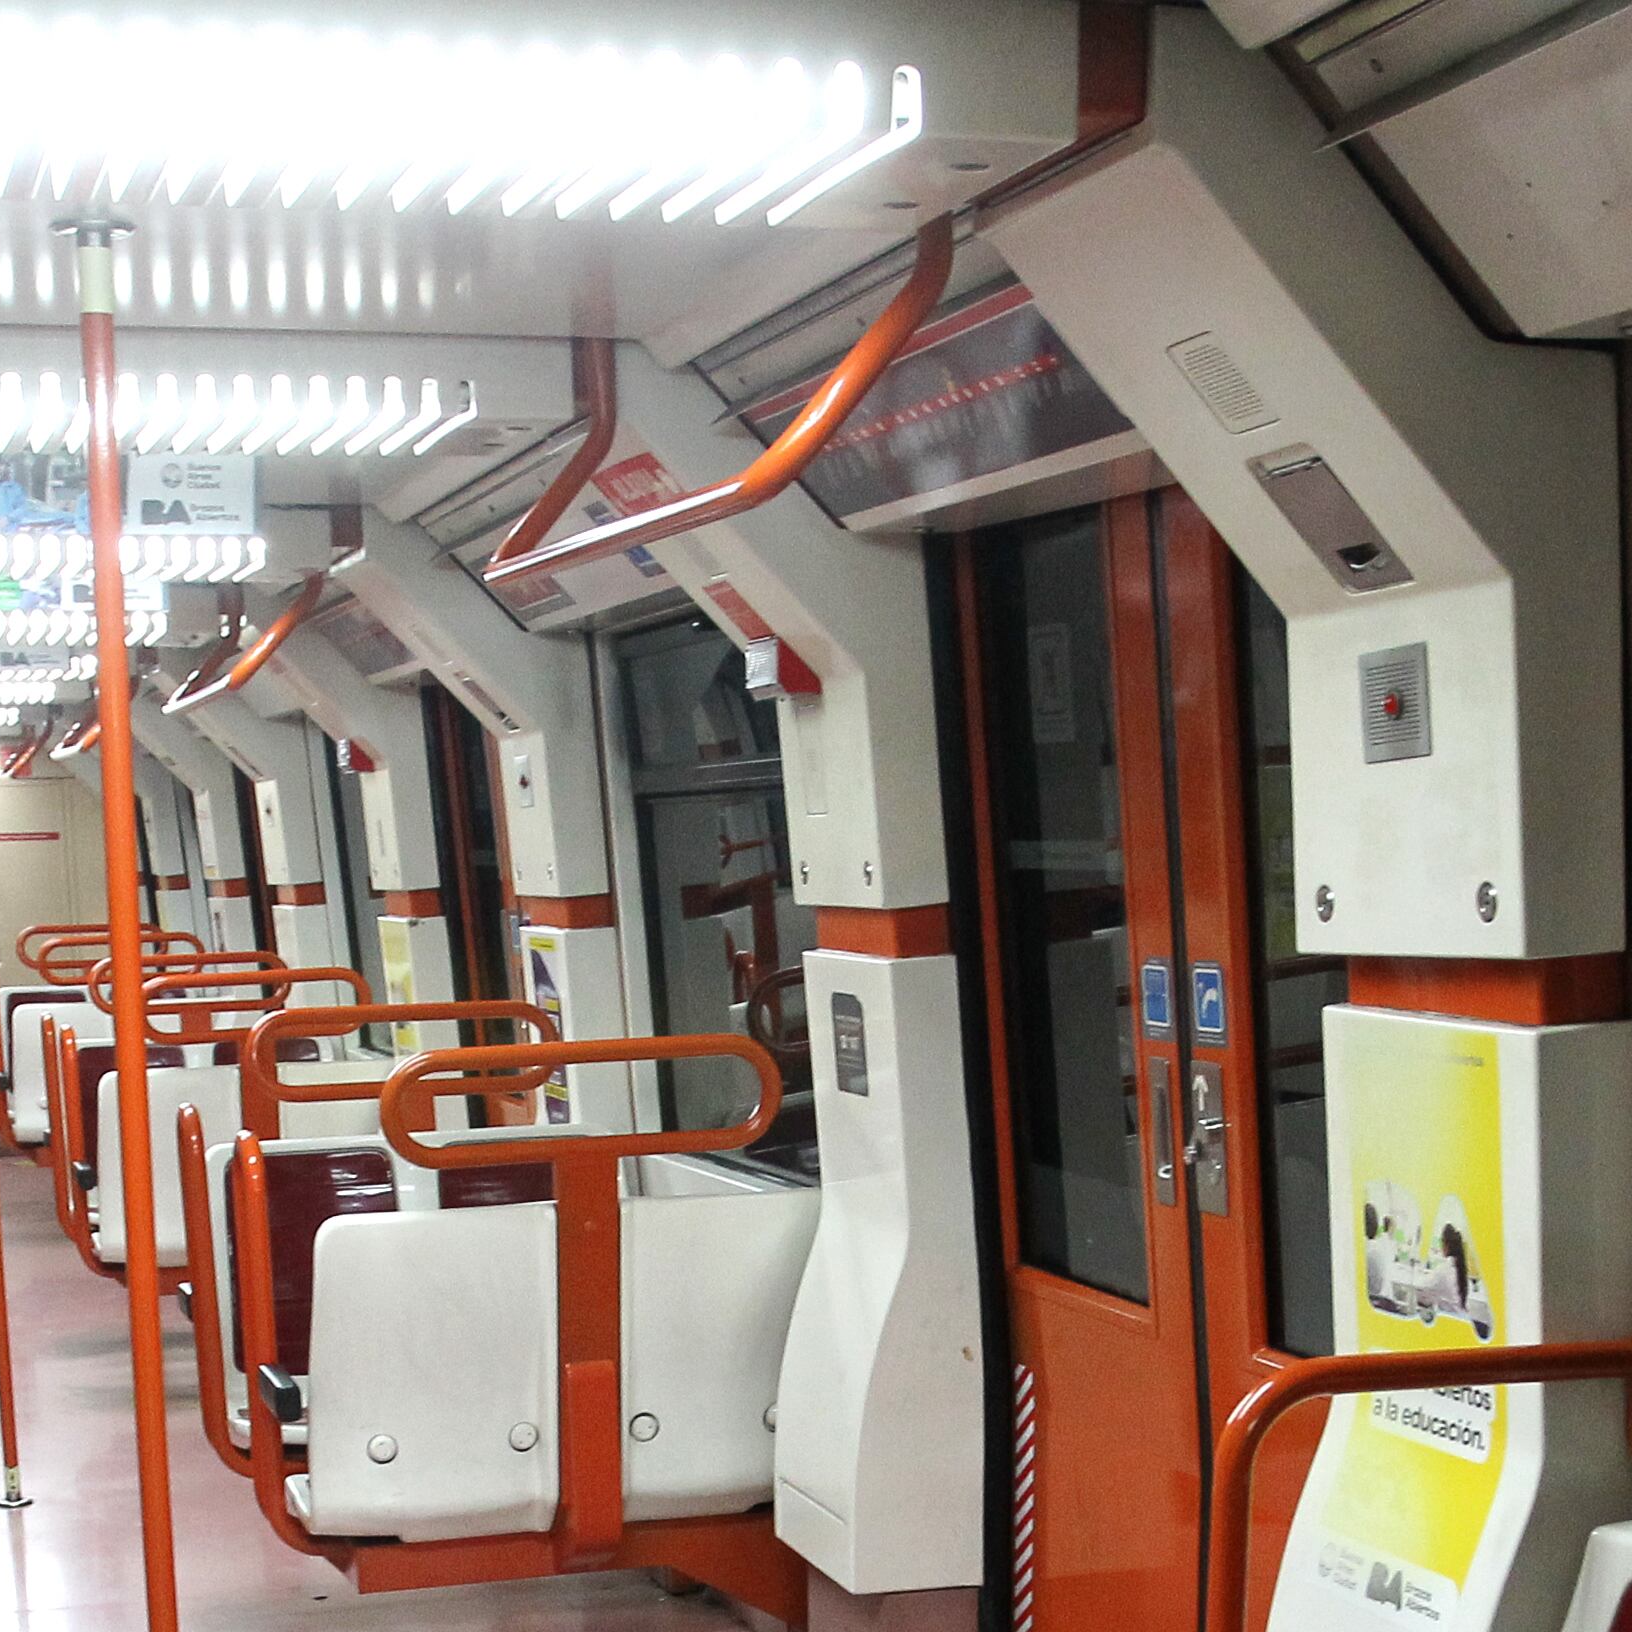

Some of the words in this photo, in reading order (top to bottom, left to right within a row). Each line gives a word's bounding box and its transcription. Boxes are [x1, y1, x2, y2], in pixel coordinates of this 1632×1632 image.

[1373, 1398, 1382, 1416] a
[1385, 1397, 1399, 1421] la
[1402, 1405, 1486, 1450] educación.
